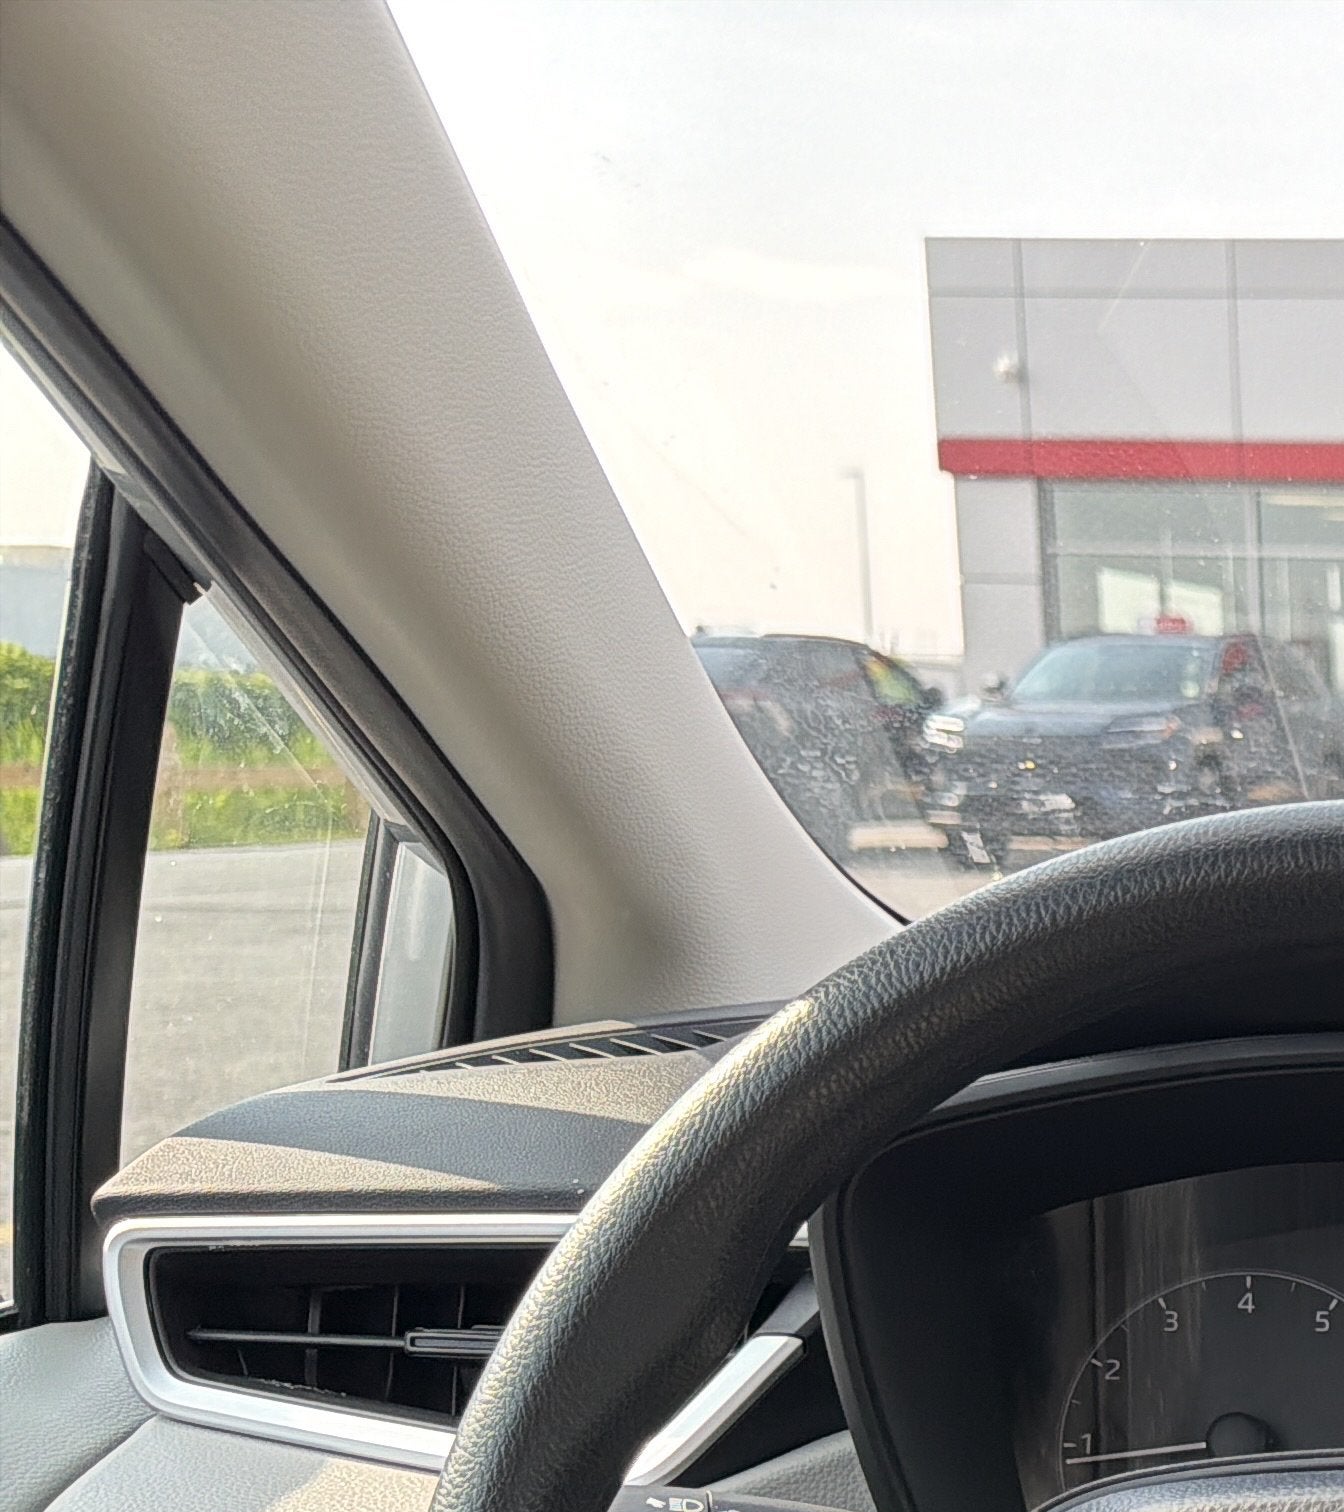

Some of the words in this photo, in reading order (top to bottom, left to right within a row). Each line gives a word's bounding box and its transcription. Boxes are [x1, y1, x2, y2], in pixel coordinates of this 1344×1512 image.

[1237, 1292, 1256, 1313] 4
[1163, 1310, 1179, 1332] 3
[1315, 1311, 1330, 1332] 5
[1104, 1359, 1121, 1380] 2
[1080, 1433, 1092, 1454] 1
